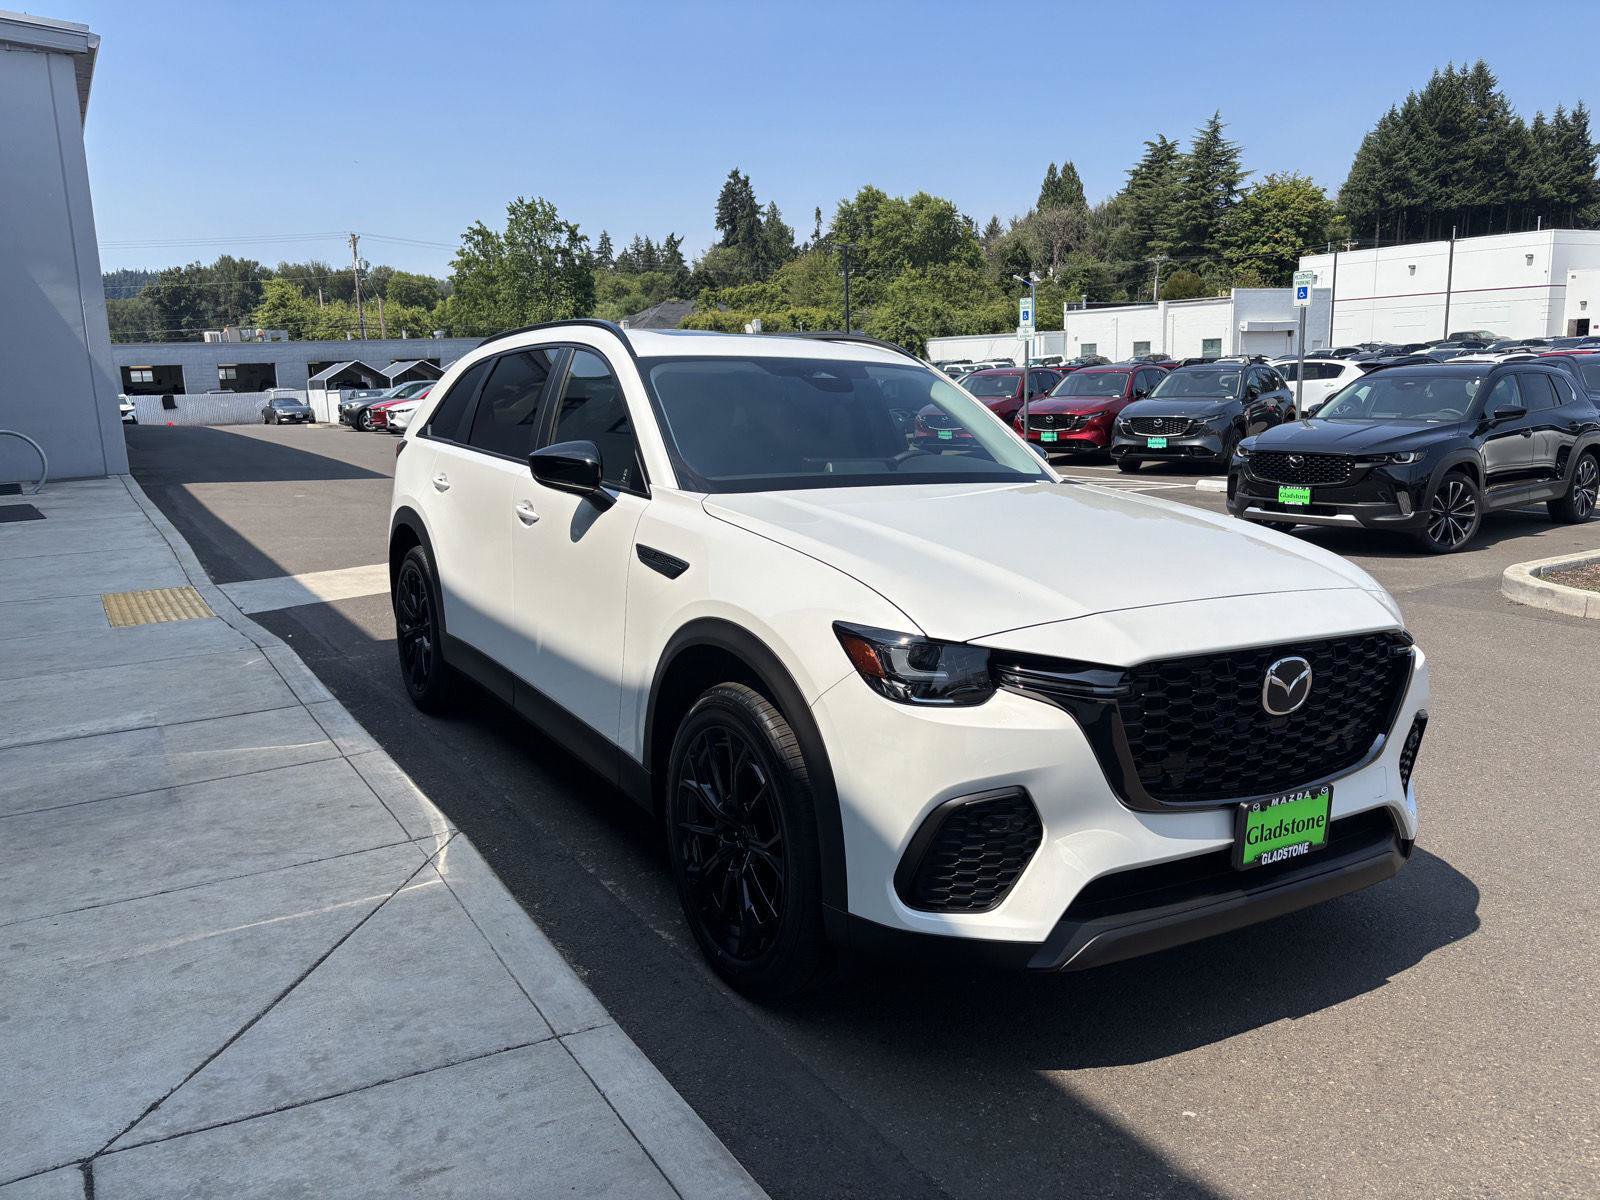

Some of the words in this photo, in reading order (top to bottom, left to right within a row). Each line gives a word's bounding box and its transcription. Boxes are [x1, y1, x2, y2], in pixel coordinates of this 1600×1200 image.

[1271, 790, 1311, 806] MAZDA
[1246, 814, 1325, 846] Gladstone
[1261, 841, 1310, 865] GLADSTONE
